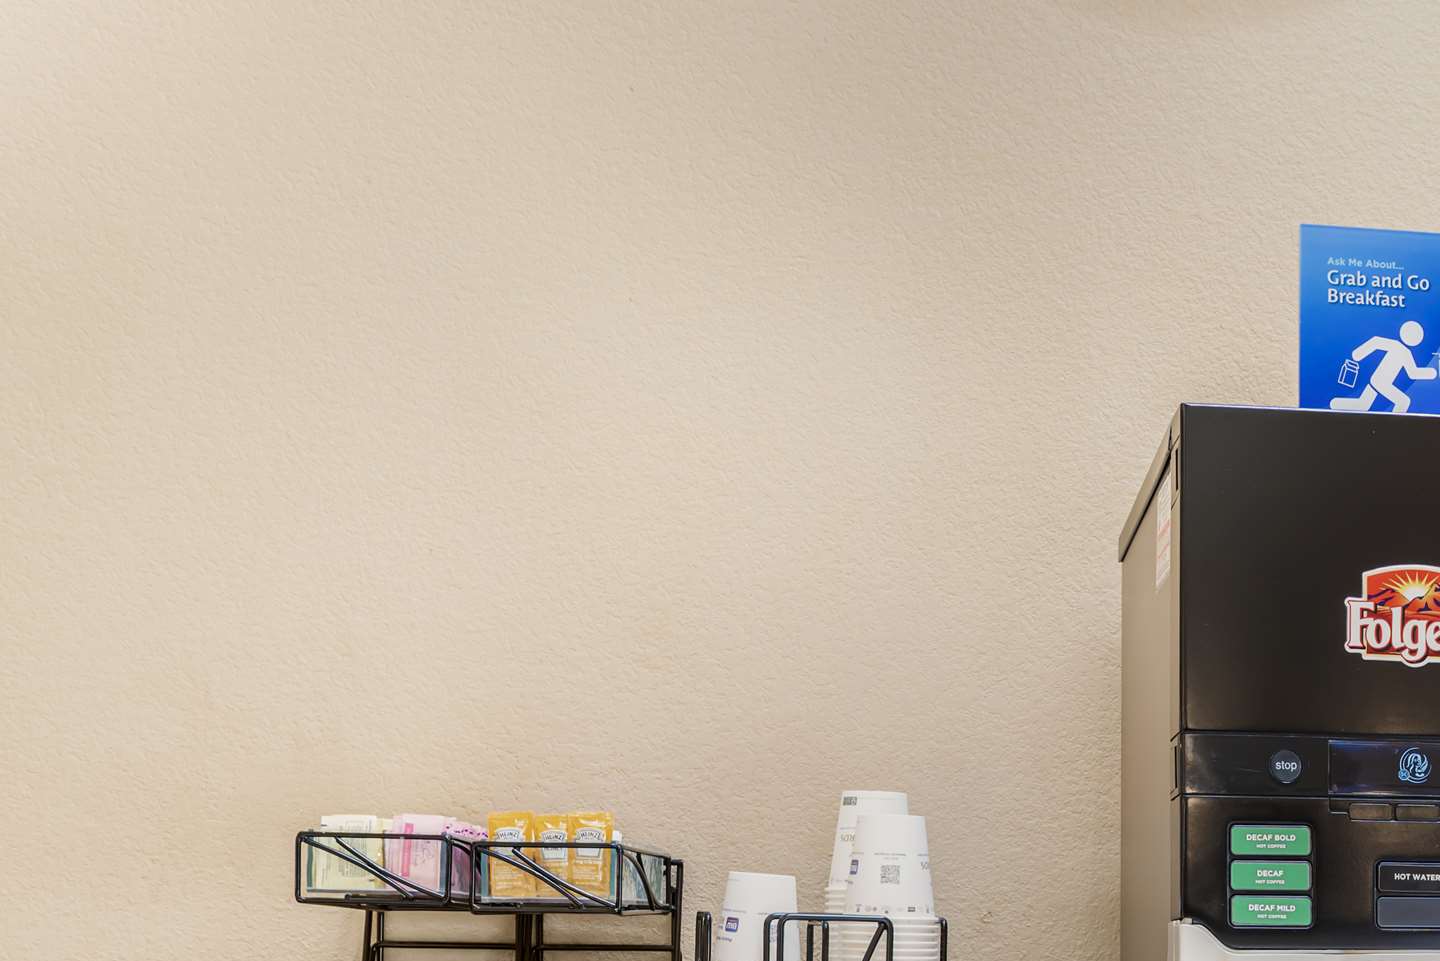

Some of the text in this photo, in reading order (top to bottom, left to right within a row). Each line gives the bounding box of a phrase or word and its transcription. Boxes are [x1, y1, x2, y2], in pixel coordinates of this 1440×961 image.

[1327, 257, 1345, 266] Ask
[1348, 258, 1363, 267] Me
[1327, 269, 1430, 291] Grab and Go
[1327, 288, 1406, 308] Breakfast
[1275, 760, 1298, 772] stop
[1246, 834, 1296, 842] DECAF BOLD
[1256, 869, 1284, 877] DECAF
[1393, 873, 1440, 881] HOT WATER
[1248, 904, 1296, 912] DECAF MILD
